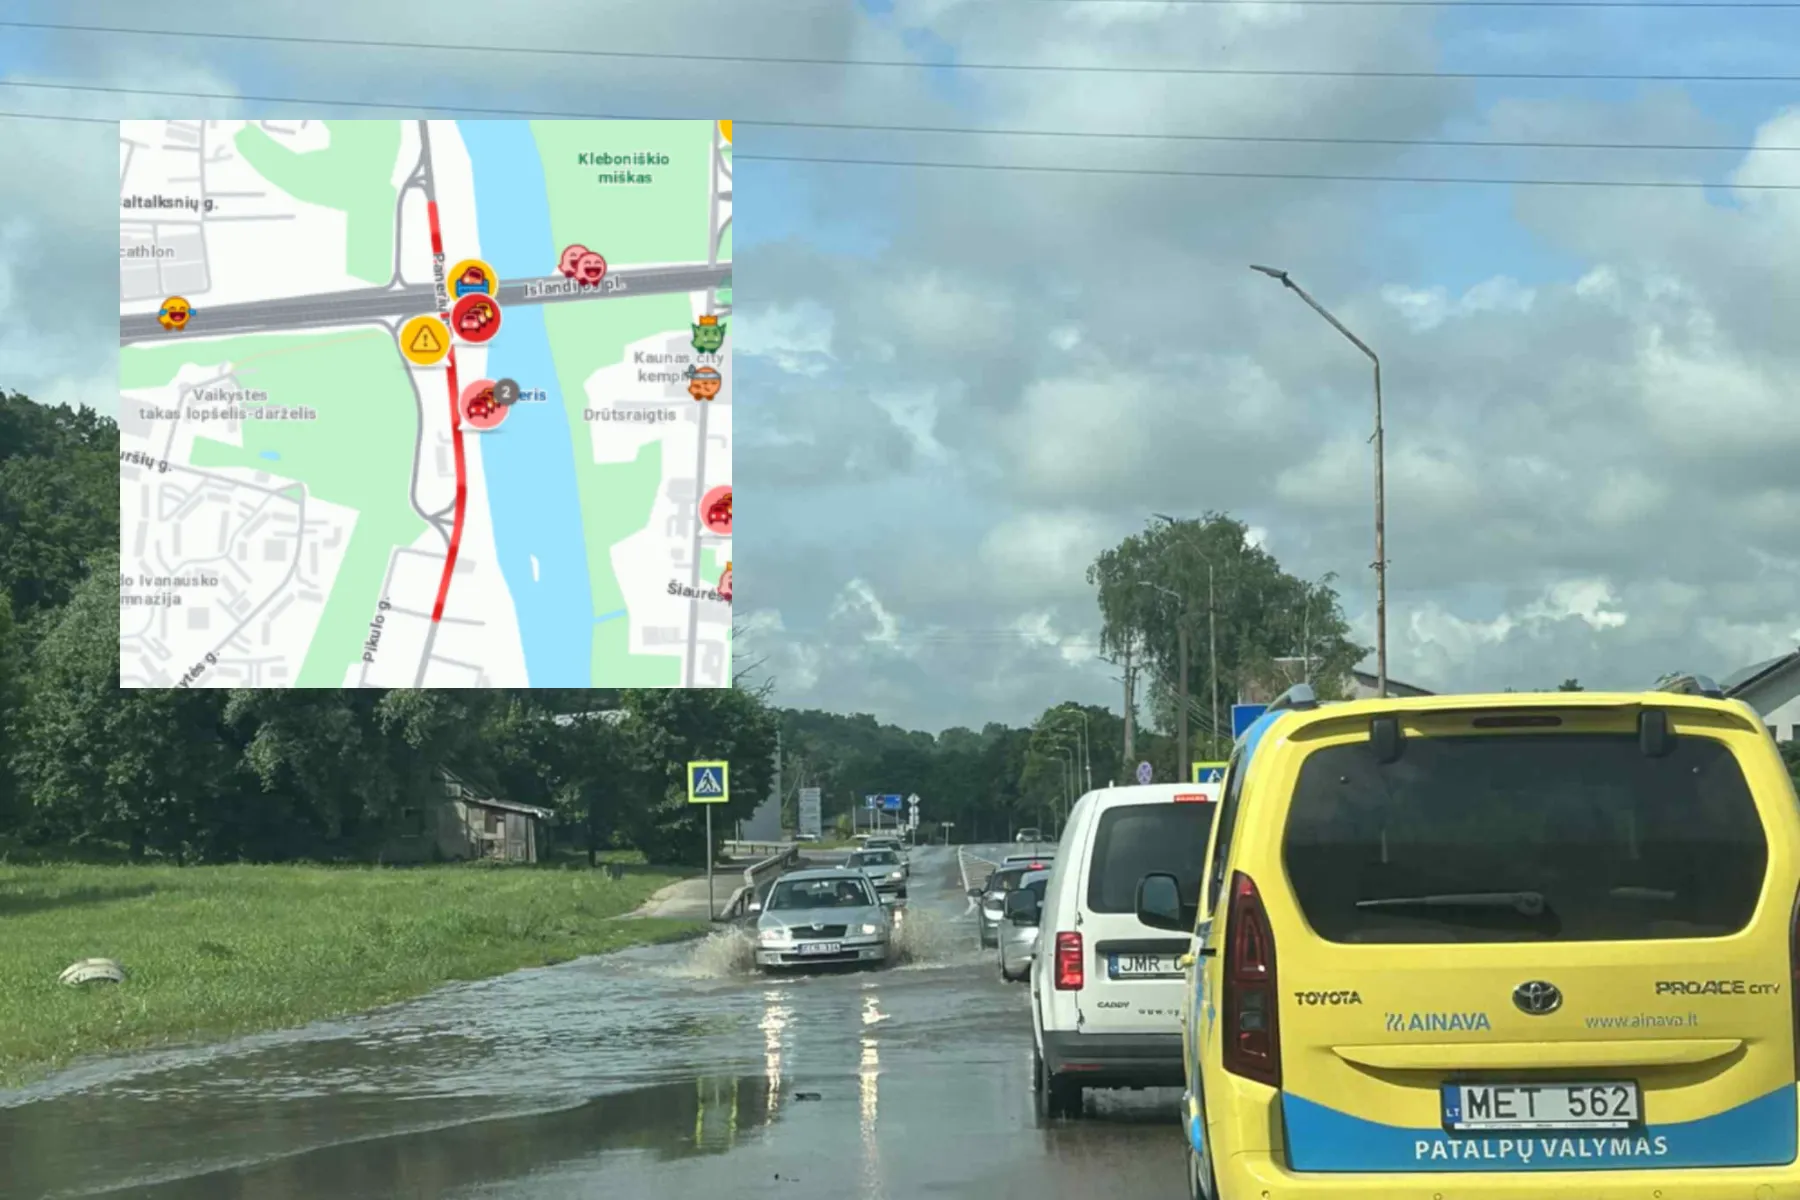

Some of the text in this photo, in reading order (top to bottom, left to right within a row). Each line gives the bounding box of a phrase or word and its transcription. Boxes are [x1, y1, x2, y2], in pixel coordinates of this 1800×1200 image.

[1121, 955, 1161, 972] JMR
[1655, 980, 1780, 995] PROACE CITY
[1294, 991, 1363, 1006] TOYOTA
[1408, 1013, 1491, 1031] AINAVA
[1585, 1012, 1698, 1028] www.ainava.lt
[1467, 1086, 1631, 1119] MET 562
[1415, 1135, 1668, 1163] PATALPŲ VALYMAS
